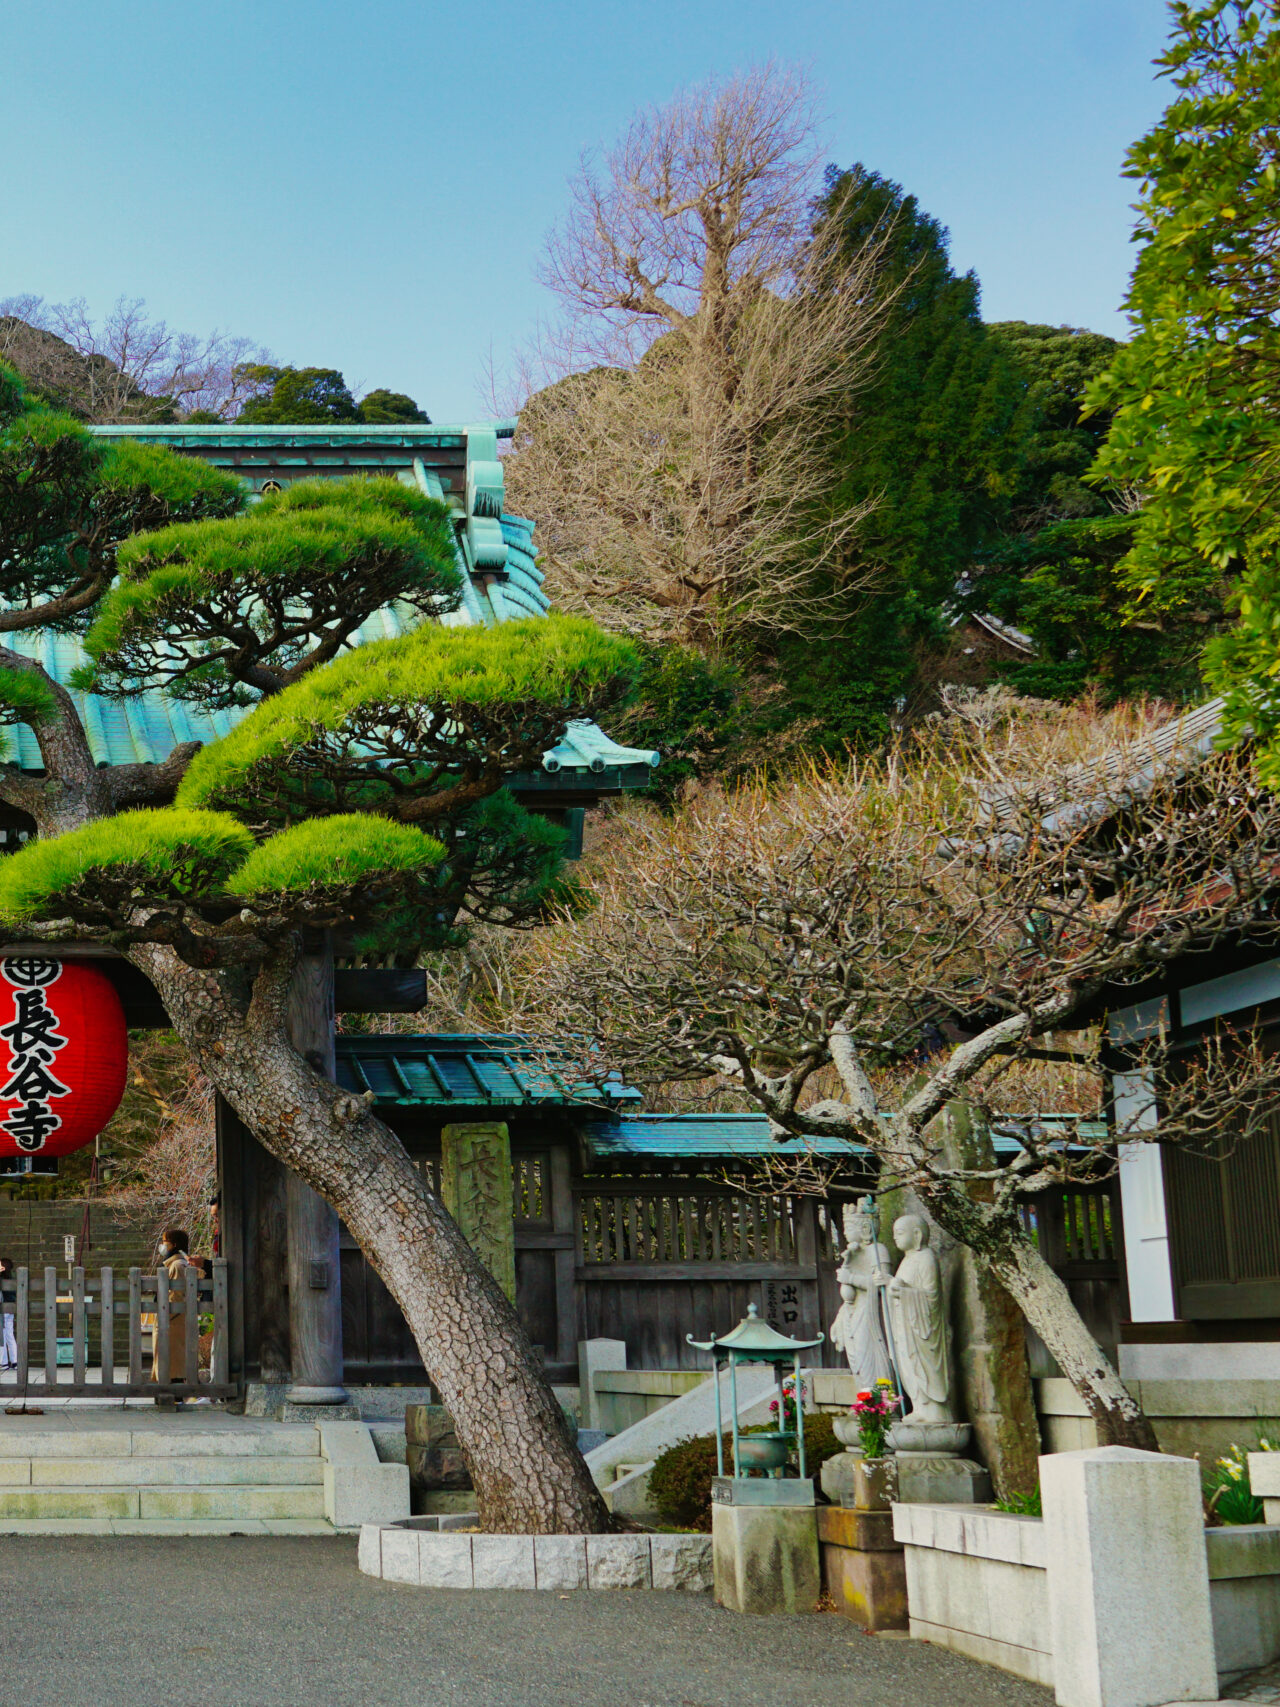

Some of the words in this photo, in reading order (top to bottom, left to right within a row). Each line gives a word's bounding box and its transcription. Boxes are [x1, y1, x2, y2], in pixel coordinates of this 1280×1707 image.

[459, 1139, 503, 1283] 長谷大
[781, 1285, 798, 1324] 出口
